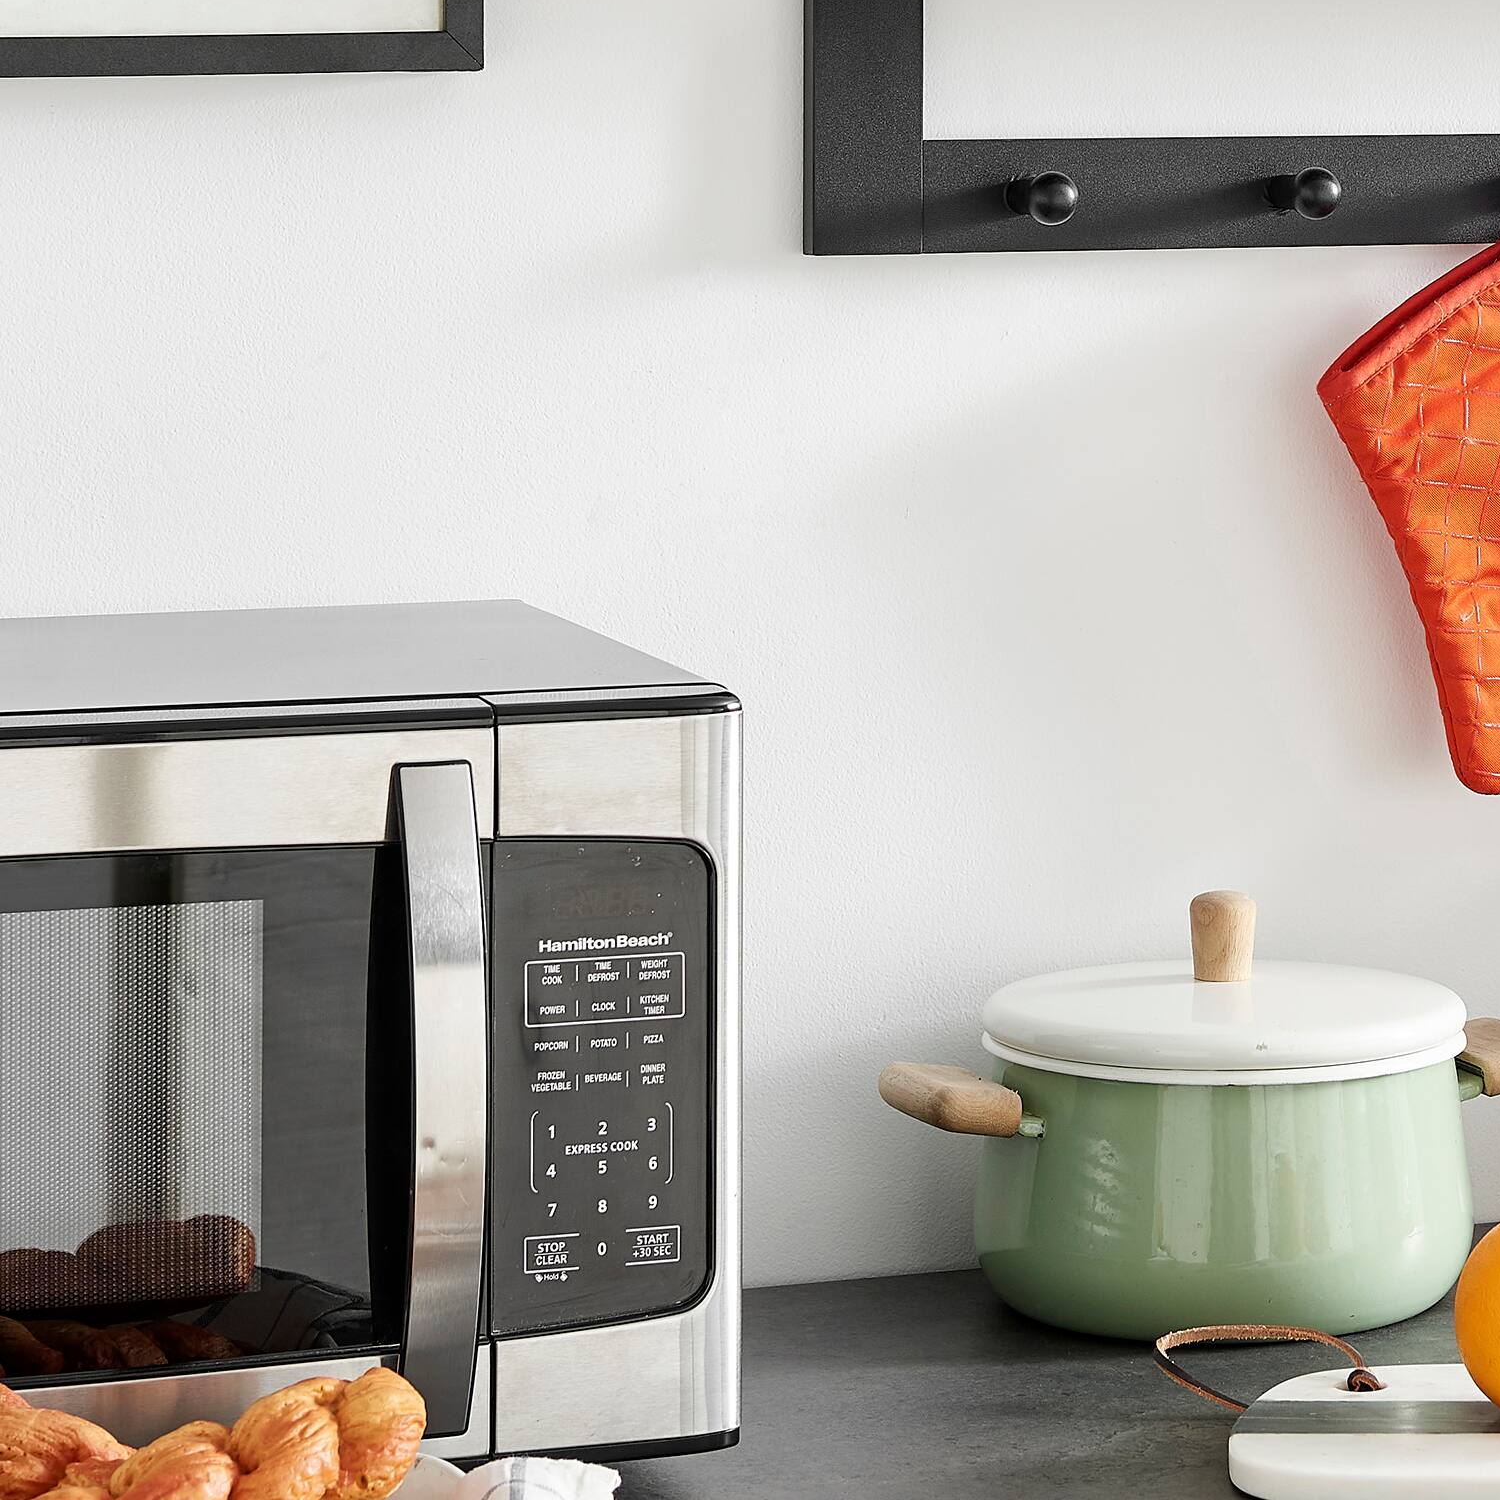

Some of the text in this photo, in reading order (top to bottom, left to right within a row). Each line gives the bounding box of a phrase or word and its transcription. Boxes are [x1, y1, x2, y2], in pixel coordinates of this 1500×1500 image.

[543, 964, 561, 974] TIME
[594, 961, 612, 971] TIME
[640, 958, 668, 969] WEIGHT
[541, 975, 563, 985] COOK
[587, 971, 620, 983] DEFROST
[638, 969, 671, 981] DEFROST
[639, 994, 670, 1005] KITCHEN
[539, 1005, 566, 1016] POWER
[591, 1001, 616, 1012] CLOCK
[643, 1005, 665, 1015] TIMER
[590, 1038, 618, 1049] POTATO
[643, 1034, 664, 1044] PIZZA
[534, 1040, 569, 1052] POPCORN
[640, 1063, 666, 1073] DINNER
[537, 1070, 566, 1081] FROZEN
[584, 1072, 623, 1084] BEVERAGE
[642, 1075, 665, 1085] PLATE
[530, 1081, 572, 1093] VEGETABLE
[598, 1121, 608, 1136] 2
[647, 1117, 657, 1132] 3
[548, 1124, 555, 1139] 1
[565, 1140, 639, 1156] EXPRESS COOK
[598, 1160, 607, 1175] 5
[648, 1156, 658, 1171] 6
[545, 1163, 557, 1178] 4
[597, 1199, 608, 1213] 8
[648, 1195, 658, 1209] 9
[547, 1202, 557, 1217] 7
[636, 1233, 670, 1245] START
[537, 1242, 566, 1253] STOP
[597, 1242, 607, 1256] 0
[632, 1245, 672, 1258] +30 SEC
[535, 1255, 568, 1266] CLEAR
[543, 1273, 559, 1281] Hold
